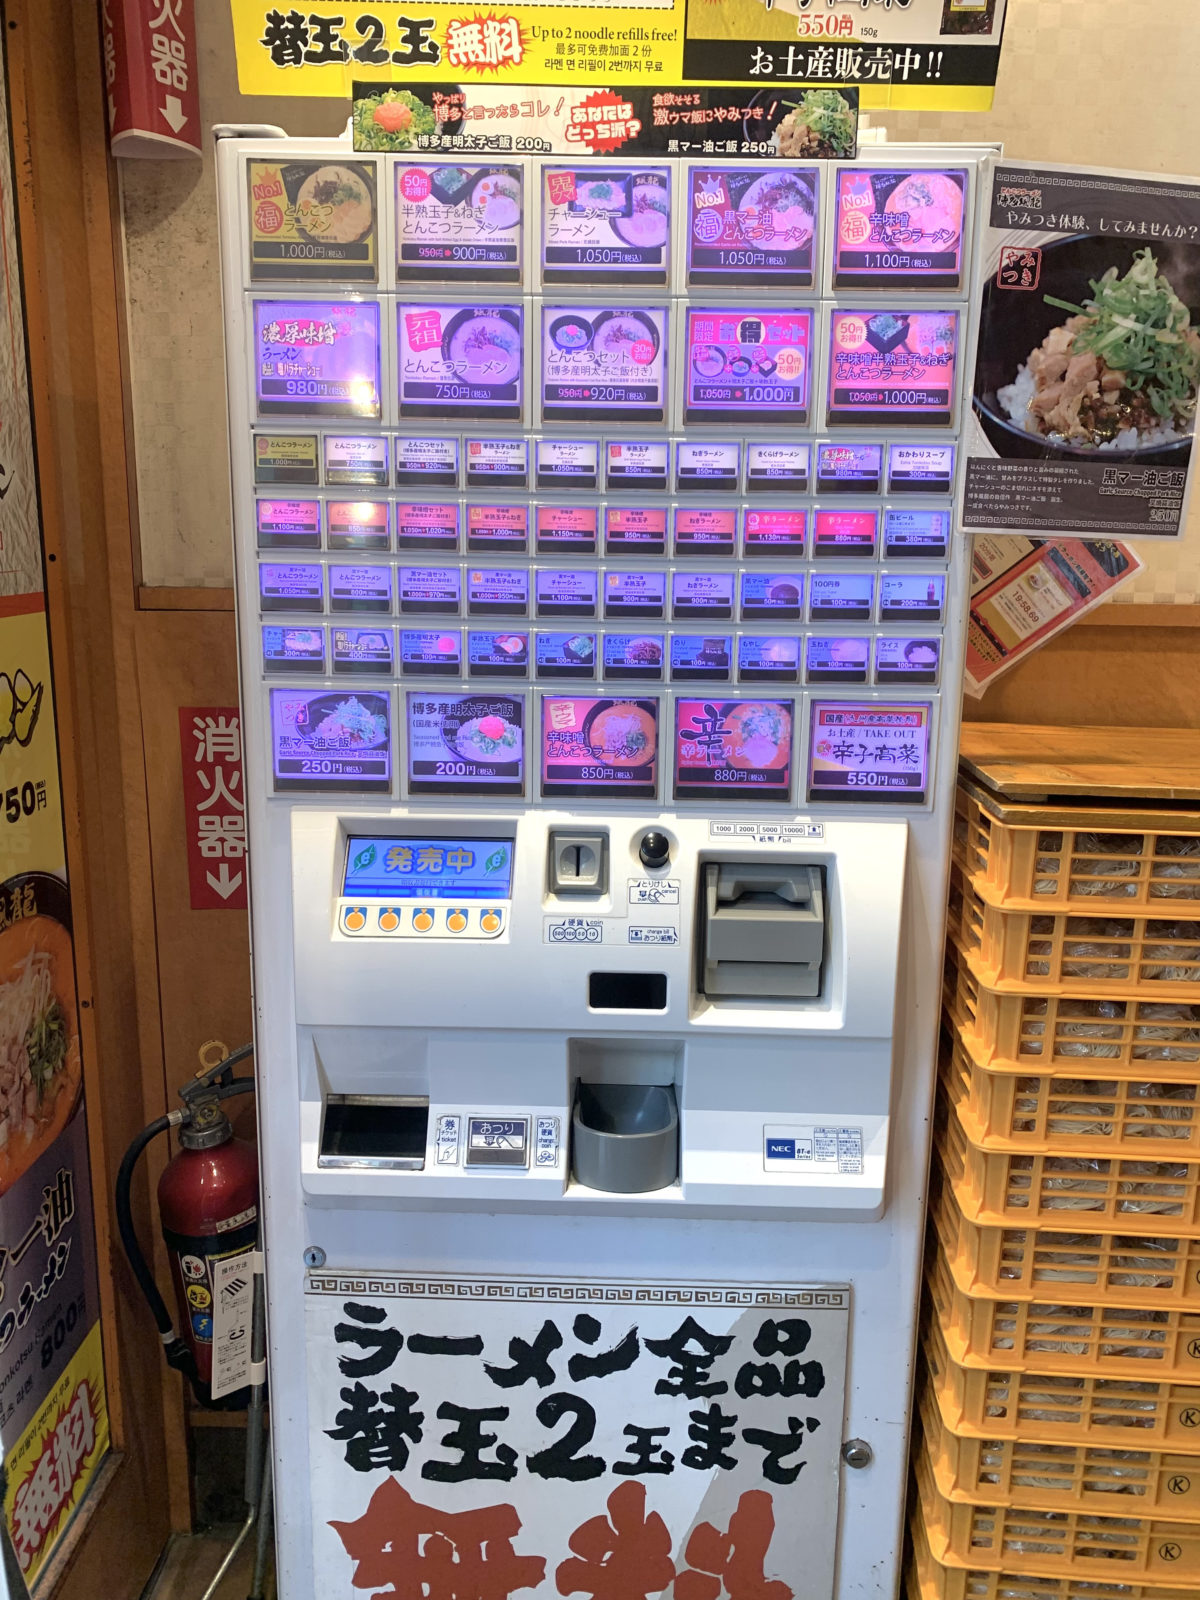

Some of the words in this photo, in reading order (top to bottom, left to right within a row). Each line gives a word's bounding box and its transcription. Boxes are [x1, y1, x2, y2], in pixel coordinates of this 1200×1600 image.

[799, 14, 853, 36] 550円
[260, 10, 440, 67] 替玉2玉
[447, 18, 521, 68] 無料
[532, 25, 549, 41] Up
[551, 27, 563, 39] to
[565, 27, 572, 39] 2
[574, 27, 614, 39] noodle
[616, 28, 649, 41] refills
[651, 29, 678, 41] free!
[860, 28, 878, 38] 150g
[544, 59, 564, 71] 라멘
[566, 59, 576, 71] 면
[578, 59, 606, 72] 리필이
[608, 60, 642, 73] 2번까지
[644, 61, 663, 72] 무료
[750, 46, 943, 80] お土産販売中!!
[432, 92, 466, 104] やっぱり
[653, 93, 700, 107] 食欲そそる
[571, 102, 633, 121] あなたは
[653, 101, 777, 126] 激ウマ飯にやみつき!
[565, 119, 641, 141] どっち派?
[417, 135, 511, 149] 博多産明太子ご飯
[516, 138, 552, 151] 200円
[667, 140, 738, 153] 黒マー油ご飯
[741, 141, 775, 154] 250円
[404, 176, 428, 187] 50円
[552, 176, 572, 191] 鬼
[254, 181, 282, 199] No.1
[405, 188, 427, 196] お得!!
[695, 189, 724, 208] No.1
[842, 191, 872, 210] No.1
[284, 203, 333, 217] とんこつ
[402, 205, 485, 219] 半熟玉子&ねぎ
[547, 208, 622, 221] チャーシュー
[723, 210, 772, 224] 黒マー油
[255, 204, 281, 232] 福
[869, 212, 910, 227] 辛味噌
[1005, 210, 1198, 239] やみつき体験、してみませんか?
[284, 220, 331, 232] ラーメン
[402, 221, 499, 234] とんこつラーメン
[548, 224, 596, 237] ラーメン
[695, 212, 721, 240] 福
[843, 214, 865, 238] 福
[723, 227, 807, 241] とんこつラーメン
[869, 229, 955, 243] とんこつラーメン
[418, 248, 444, 257] 950円
[408, 315, 440, 346] 元祖
[840, 323, 863, 333] 50円
[262, 347, 302, 360] ラーメン
[634, 344, 652, 353] 30円
[547, 350, 629, 363] とんこつセット
[777, 354, 801, 364] 50円
[404, 359, 508, 374] とんこつラーメン
[836, 367, 926, 380] とんこつラーメン
[743, 387, 794, 402] 1,000円
[334, 442, 377, 450] とんこつラーメン
[898, 451, 945, 459] おかわりスープ
[1102, 468, 1185, 488] 黒マー油ご飯
[742, 640, 761, 648] もやし
[412, 703, 514, 717] 博多産明太子ご飯
[547, 731, 585, 744] 辛味噌
[680, 704, 733, 766] 辛
[864, 729, 891, 738] TAKE
[893, 730, 917, 738] OUT
[279, 735, 350, 748] 黒マー油ご飯
[547, 744, 639, 758] とんこつラーメン
[832, 740, 920, 765] 辛子高菜
[301, 760, 363, 774] 250円(税込)
[435, 762, 497, 776] 200円(税込)
[847, 772, 909, 786] 550円(税込)
[193, 716, 246, 858] 消火器
[0, 780, 47, 824] 50円
[385, 846, 474, 875] 発売中
[444, 1119, 456, 1131] 券
[480, 1122, 515, 1136] おつり
[771, 1145, 792, 1153] NEC
[334, 1301, 826, 1400] ラーメン全品
[322, 1381, 821, 1485] 替玉2玉まで
[13, 1377, 96, 1574] 無料
